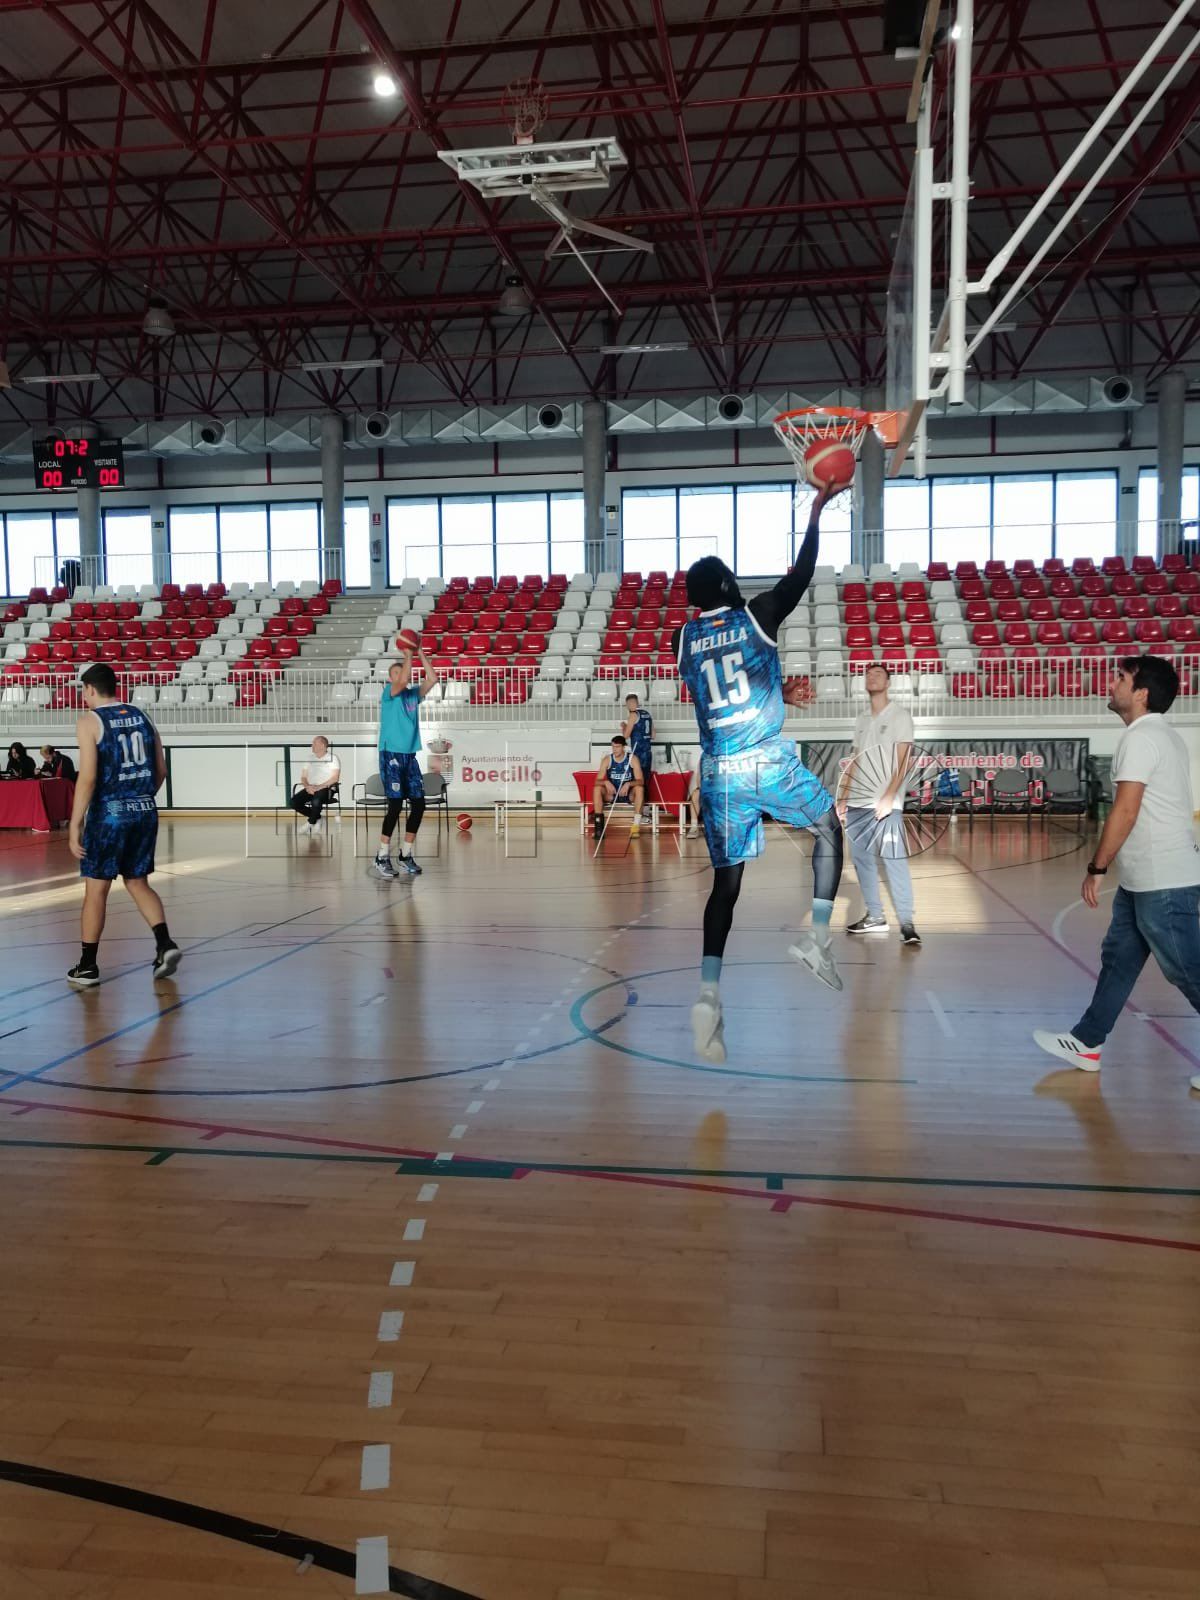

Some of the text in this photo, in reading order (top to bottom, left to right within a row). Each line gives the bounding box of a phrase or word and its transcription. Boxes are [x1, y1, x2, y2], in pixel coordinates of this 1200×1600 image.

[43, 470, 63, 487] 00
[99, 468, 119, 485] 00
[690, 627, 748, 655] MELILLA
[700, 651, 751, 710] 15
[109, 716, 144, 728] MELILLA
[118, 731, 147, 768] 10
[461, 755, 520, 763] Ayuntamiento
[907, 752, 1044, 768] untamiento de
[461, 766, 542, 782] Boecillo
